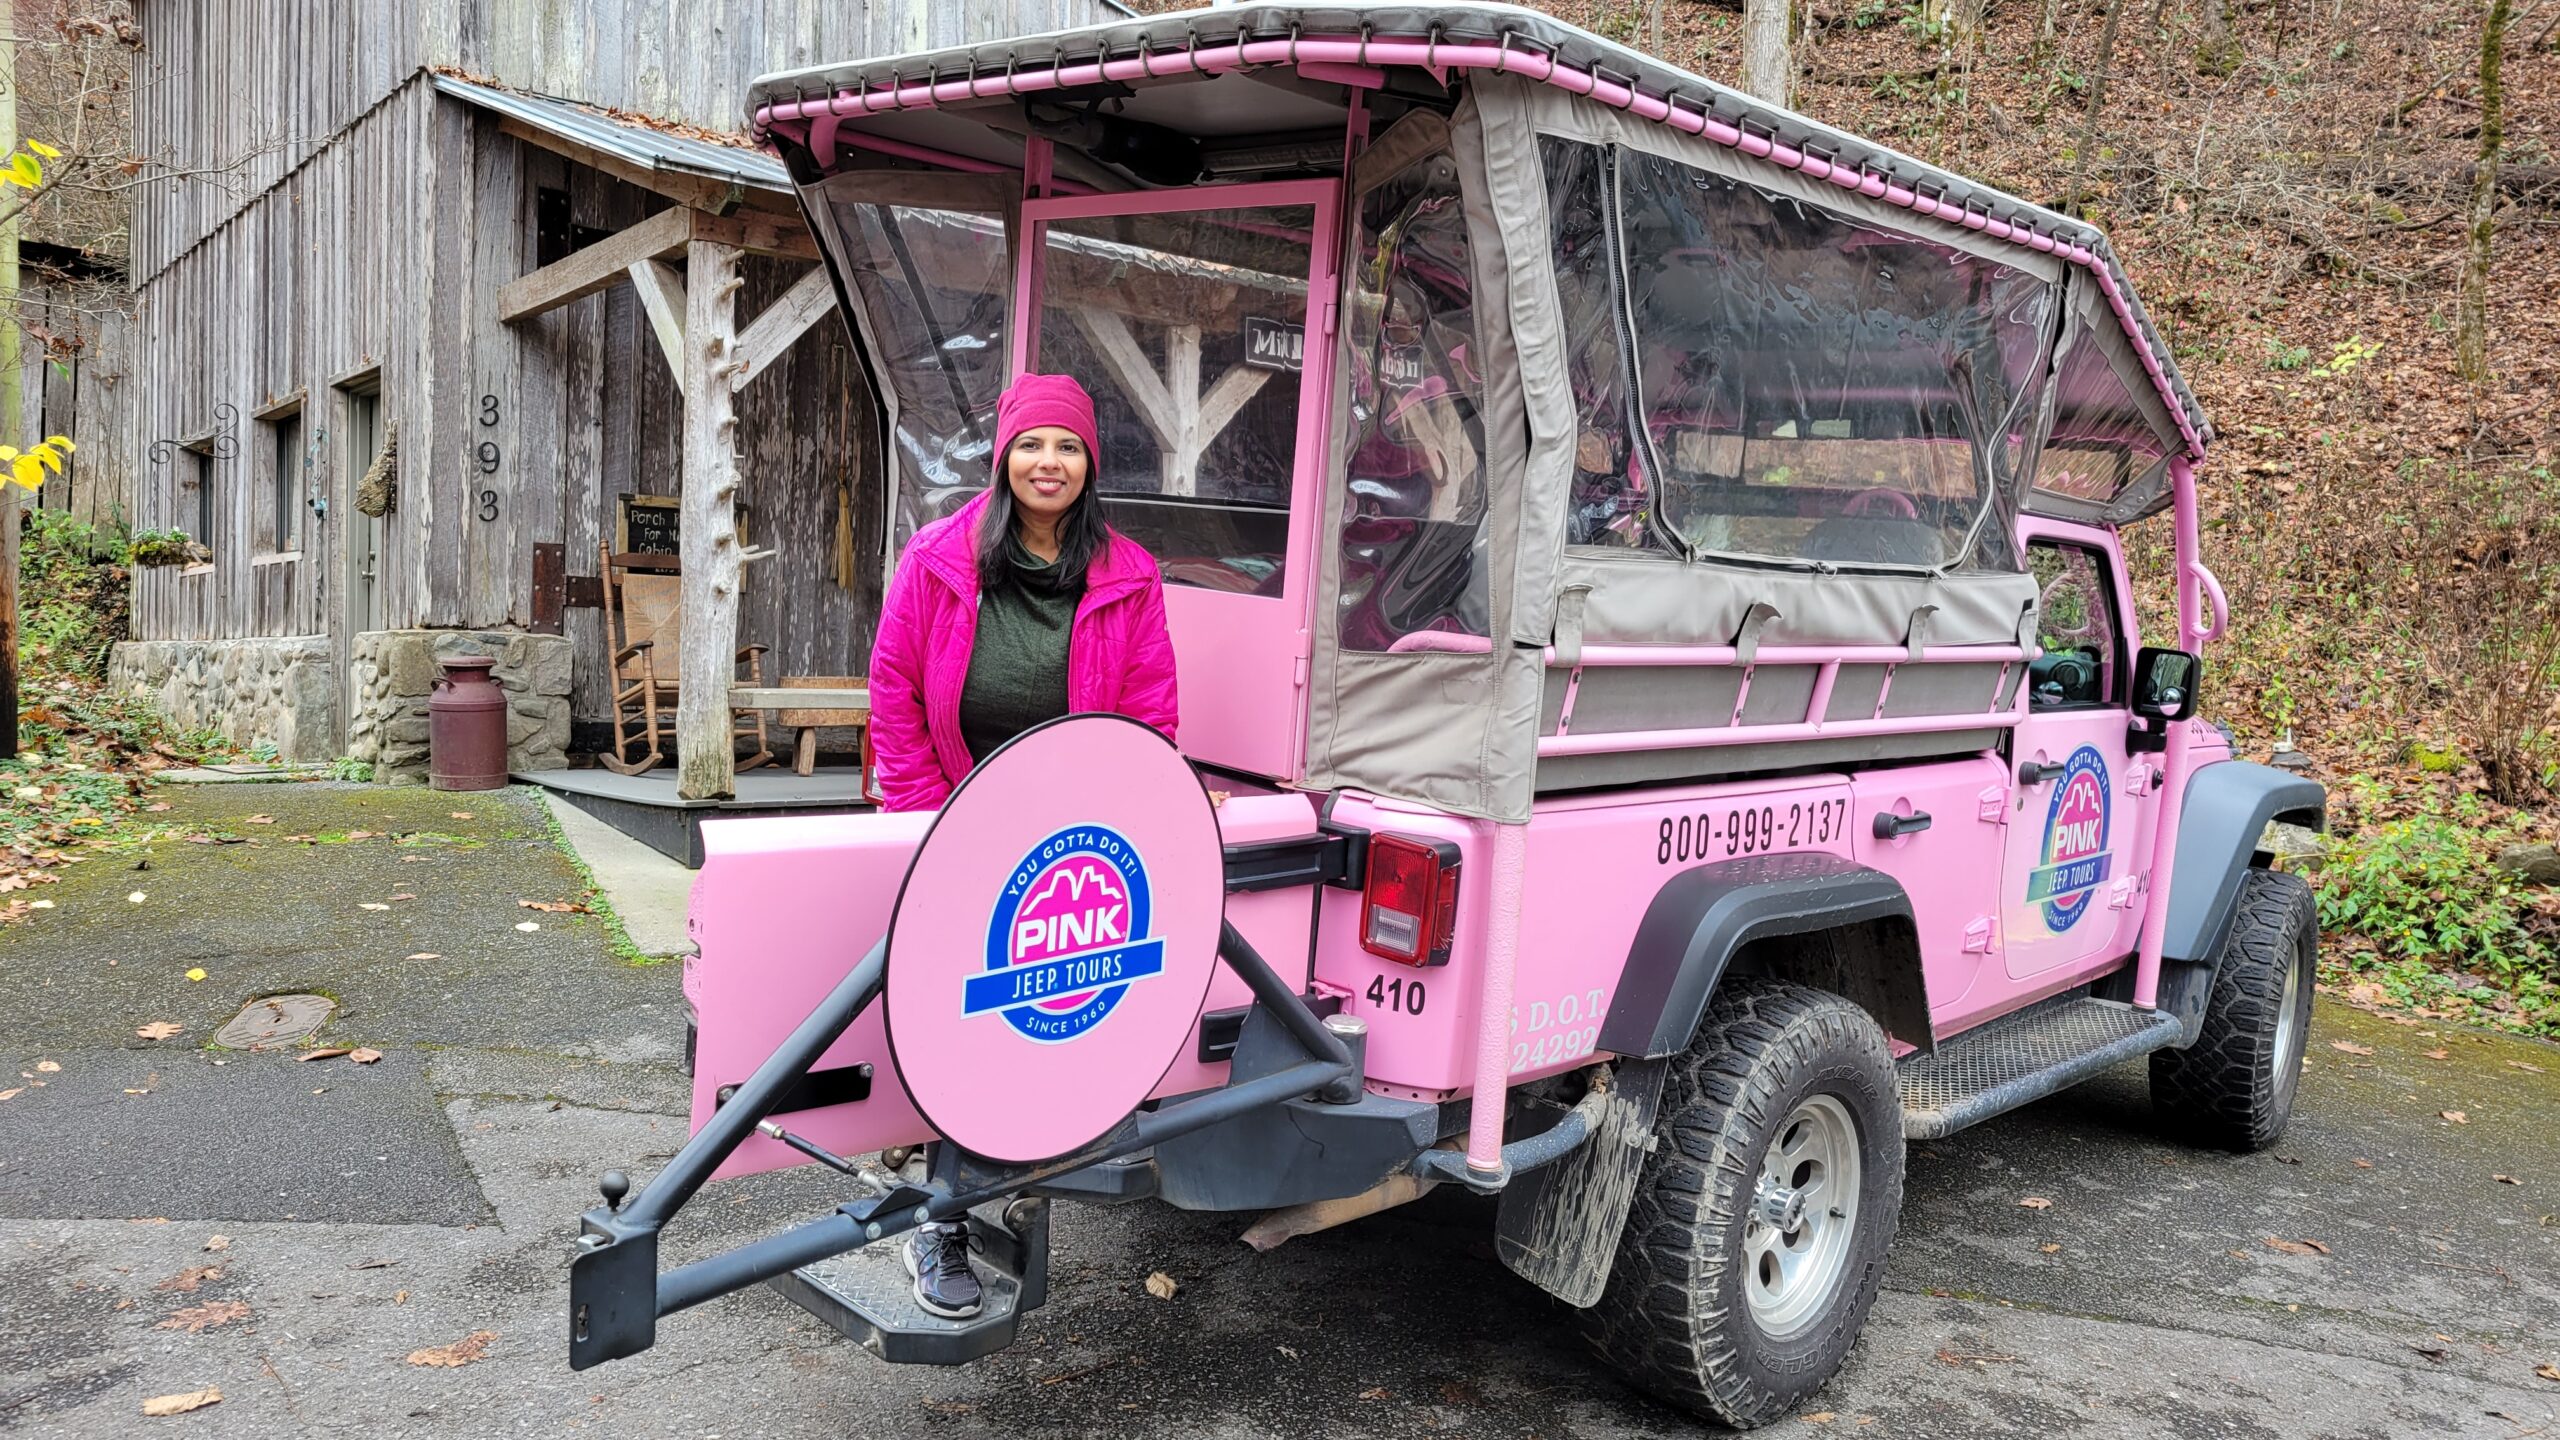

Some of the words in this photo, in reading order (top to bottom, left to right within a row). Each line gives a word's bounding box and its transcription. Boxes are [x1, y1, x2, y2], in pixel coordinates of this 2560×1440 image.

[478, 394, 501, 522] 393
[631, 509, 666, 526] Porch
[643, 527, 661, 541] For
[2053, 771, 2069, 803] YOU
[2069, 752, 2092, 773] GOTTA
[2092, 756, 2102, 774] DO
[1656, 798, 1847, 866] 800-999-2137
[2053, 817, 2100, 859] PINK
[1007, 858, 1039, 897] YOU
[1042, 832, 1094, 860] GOTTA
[1098, 835, 1120, 855] DO
[1120, 852, 1138, 878] IT!
[2046, 868, 2069, 893] JEEP
[2070, 861, 2096, 887] TOURS
[1015, 903, 1124, 960] PINK
[2048, 909, 2066, 927] SINCE
[2067, 902, 2084, 924] 1960
[1012, 967, 1058, 999] JEEP
[1065, 953, 1123, 987] TOURS
[1366, 974, 1426, 1016] 410
[1026, 1016, 1068, 1034] SINCE
[1073, 1000, 1106, 1029] 1960
[1527, 987, 1606, 1034] D.O.T.
